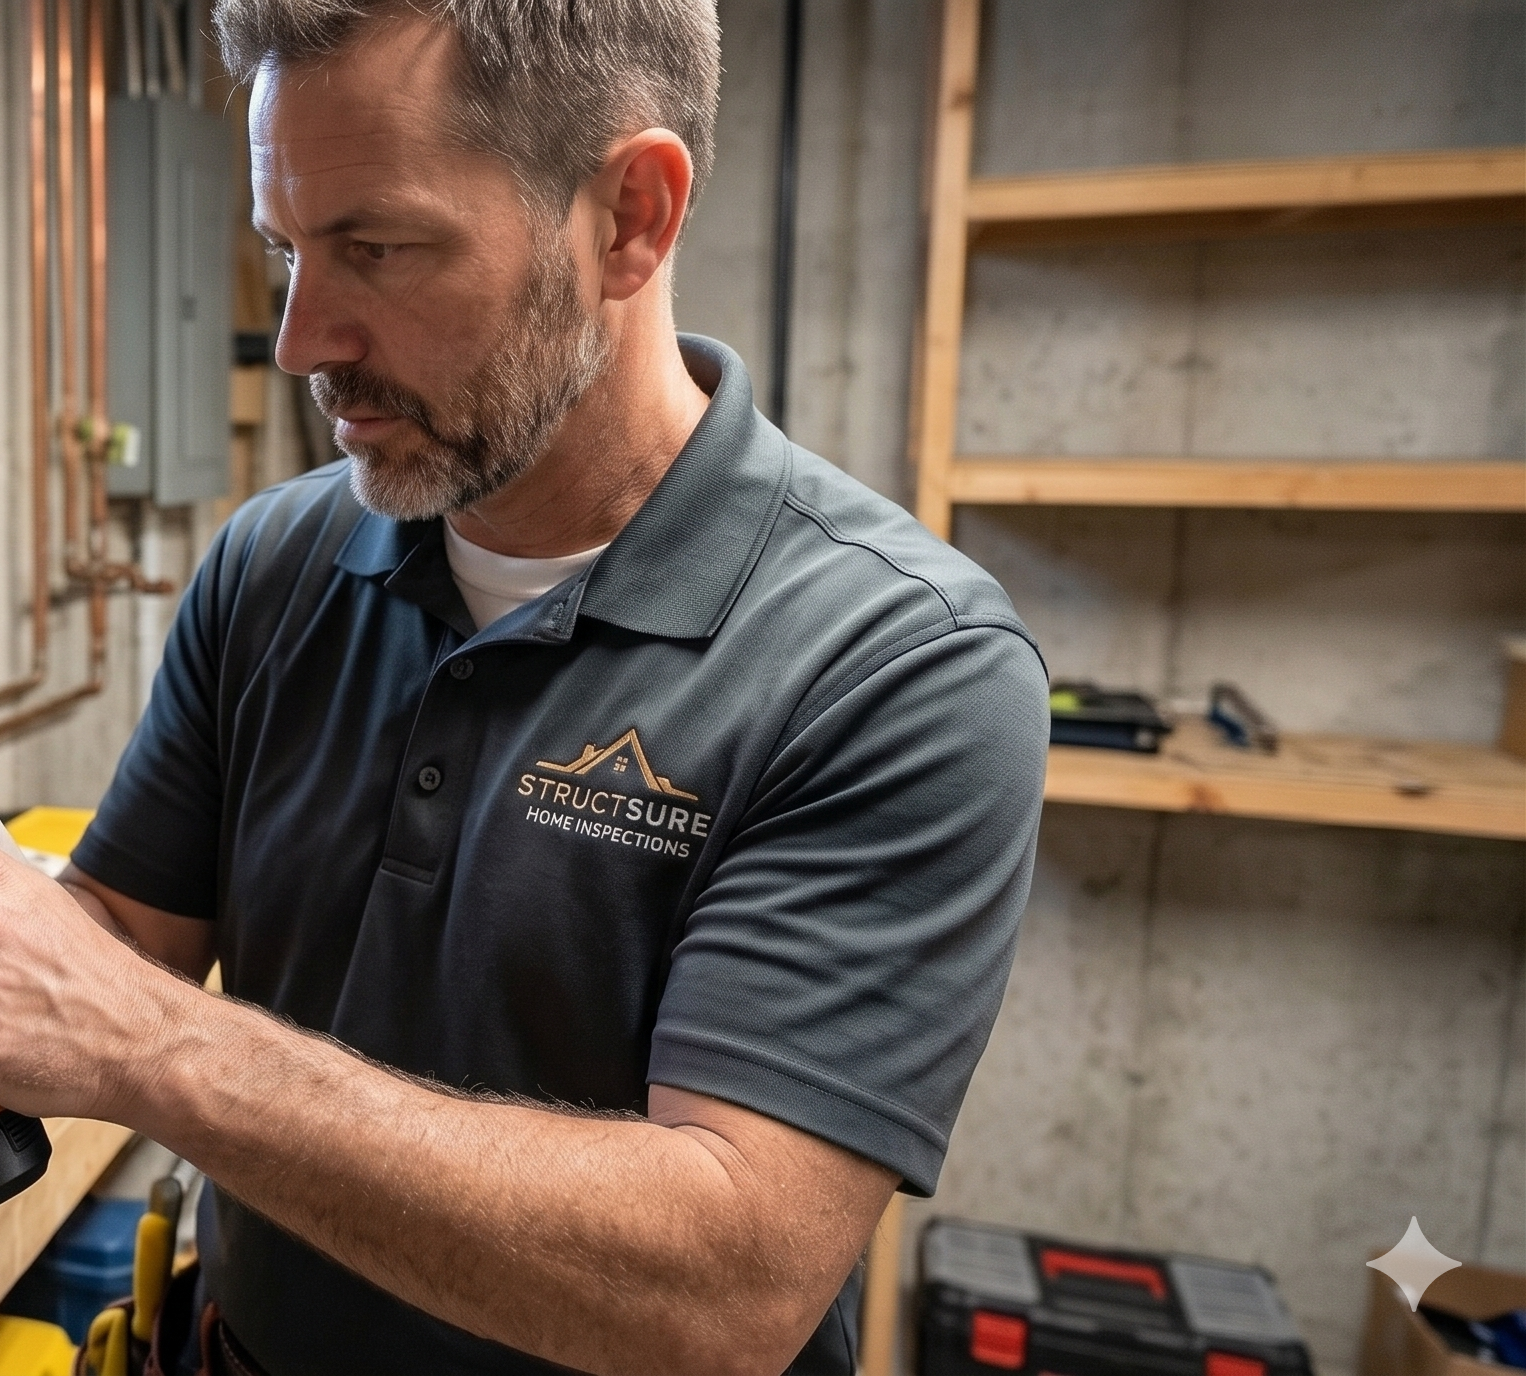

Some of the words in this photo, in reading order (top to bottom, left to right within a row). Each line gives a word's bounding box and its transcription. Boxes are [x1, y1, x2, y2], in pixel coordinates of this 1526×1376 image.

[517, 773, 712, 838] STRUCTSURE
[525, 805, 574, 831] HOME
[575, 818, 691, 858] INSPECTIONS
